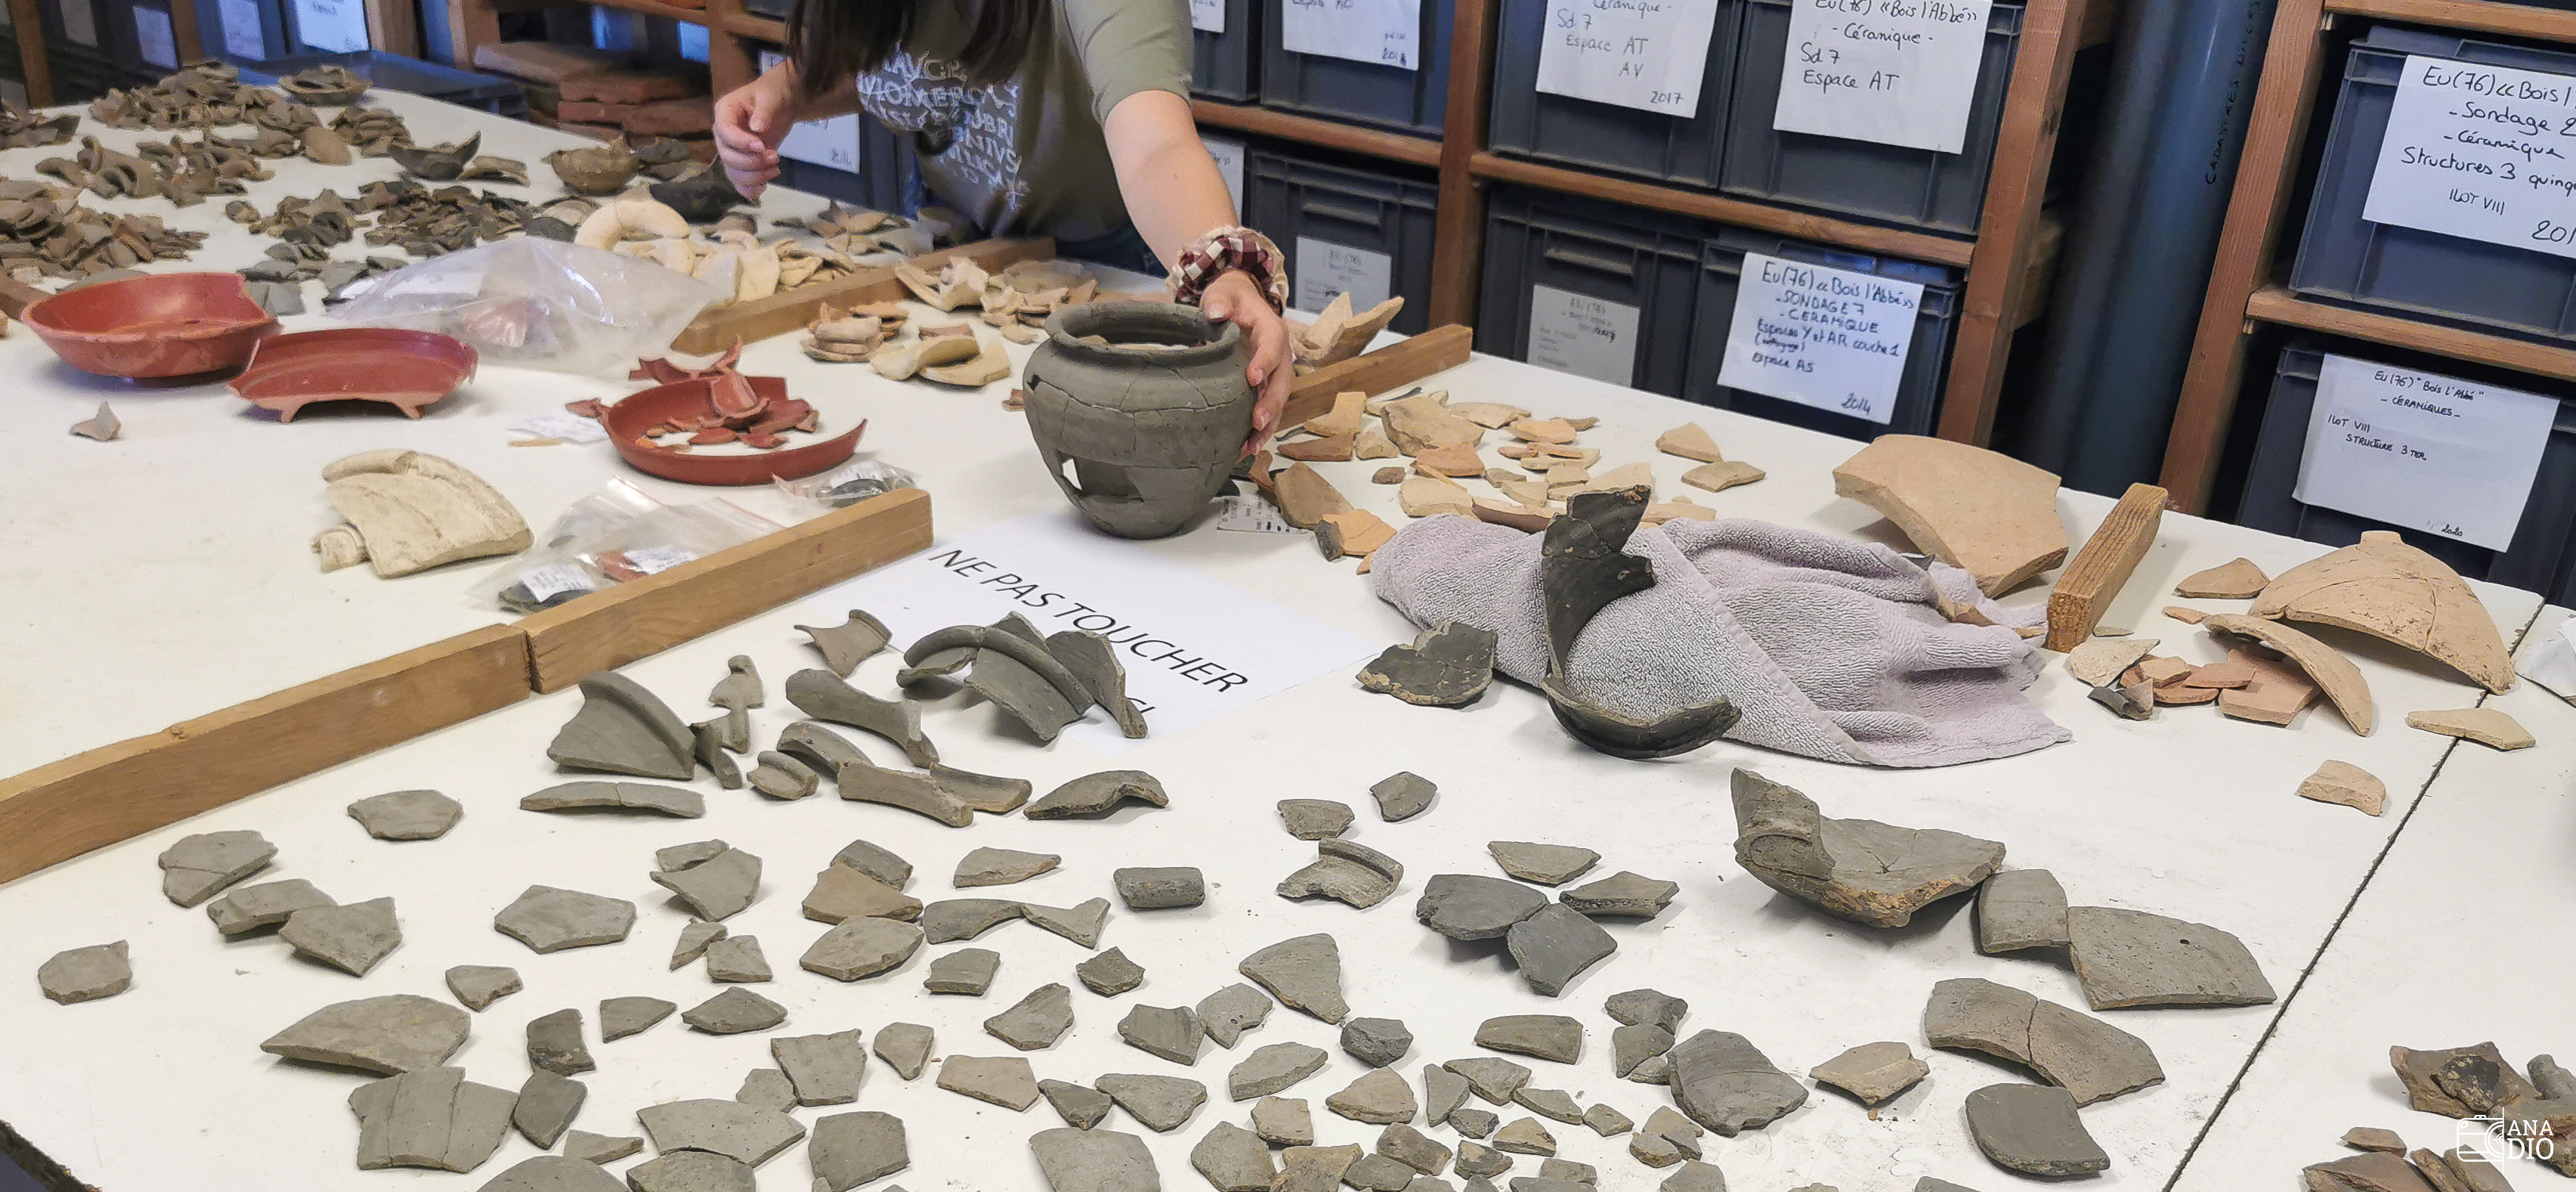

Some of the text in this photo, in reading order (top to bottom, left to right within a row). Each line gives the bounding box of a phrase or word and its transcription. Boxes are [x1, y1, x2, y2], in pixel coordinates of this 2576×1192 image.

[1582, 14, 1593, 30] 7
[1566, 34, 1649, 55] Espace AT
[1801, 42, 1841, 64] Sd 7
[1804, 69, 1900, 94] Espace AT
[1650, 91, 1684, 104] 2017
[2461, 101, 2553, 136] Sondage
[2401, 146, 2493, 175] Structures
[2500, 163, 2516, 180] 3
[1784, 289, 1848, 316] SONDAGE
[1852, 303, 1865, 316] 7
[1802, 326, 1812, 339] Y
[1827, 331, 1848, 348] AR
[1889, 342, 1899, 358] 1
[1842, 393, 1872, 416] 2014
[2354, 421, 2370, 434] VIII
[2401, 445, 2408, 456] 3
[927, 550, 1248, 692] NE PAS TOUCHER
